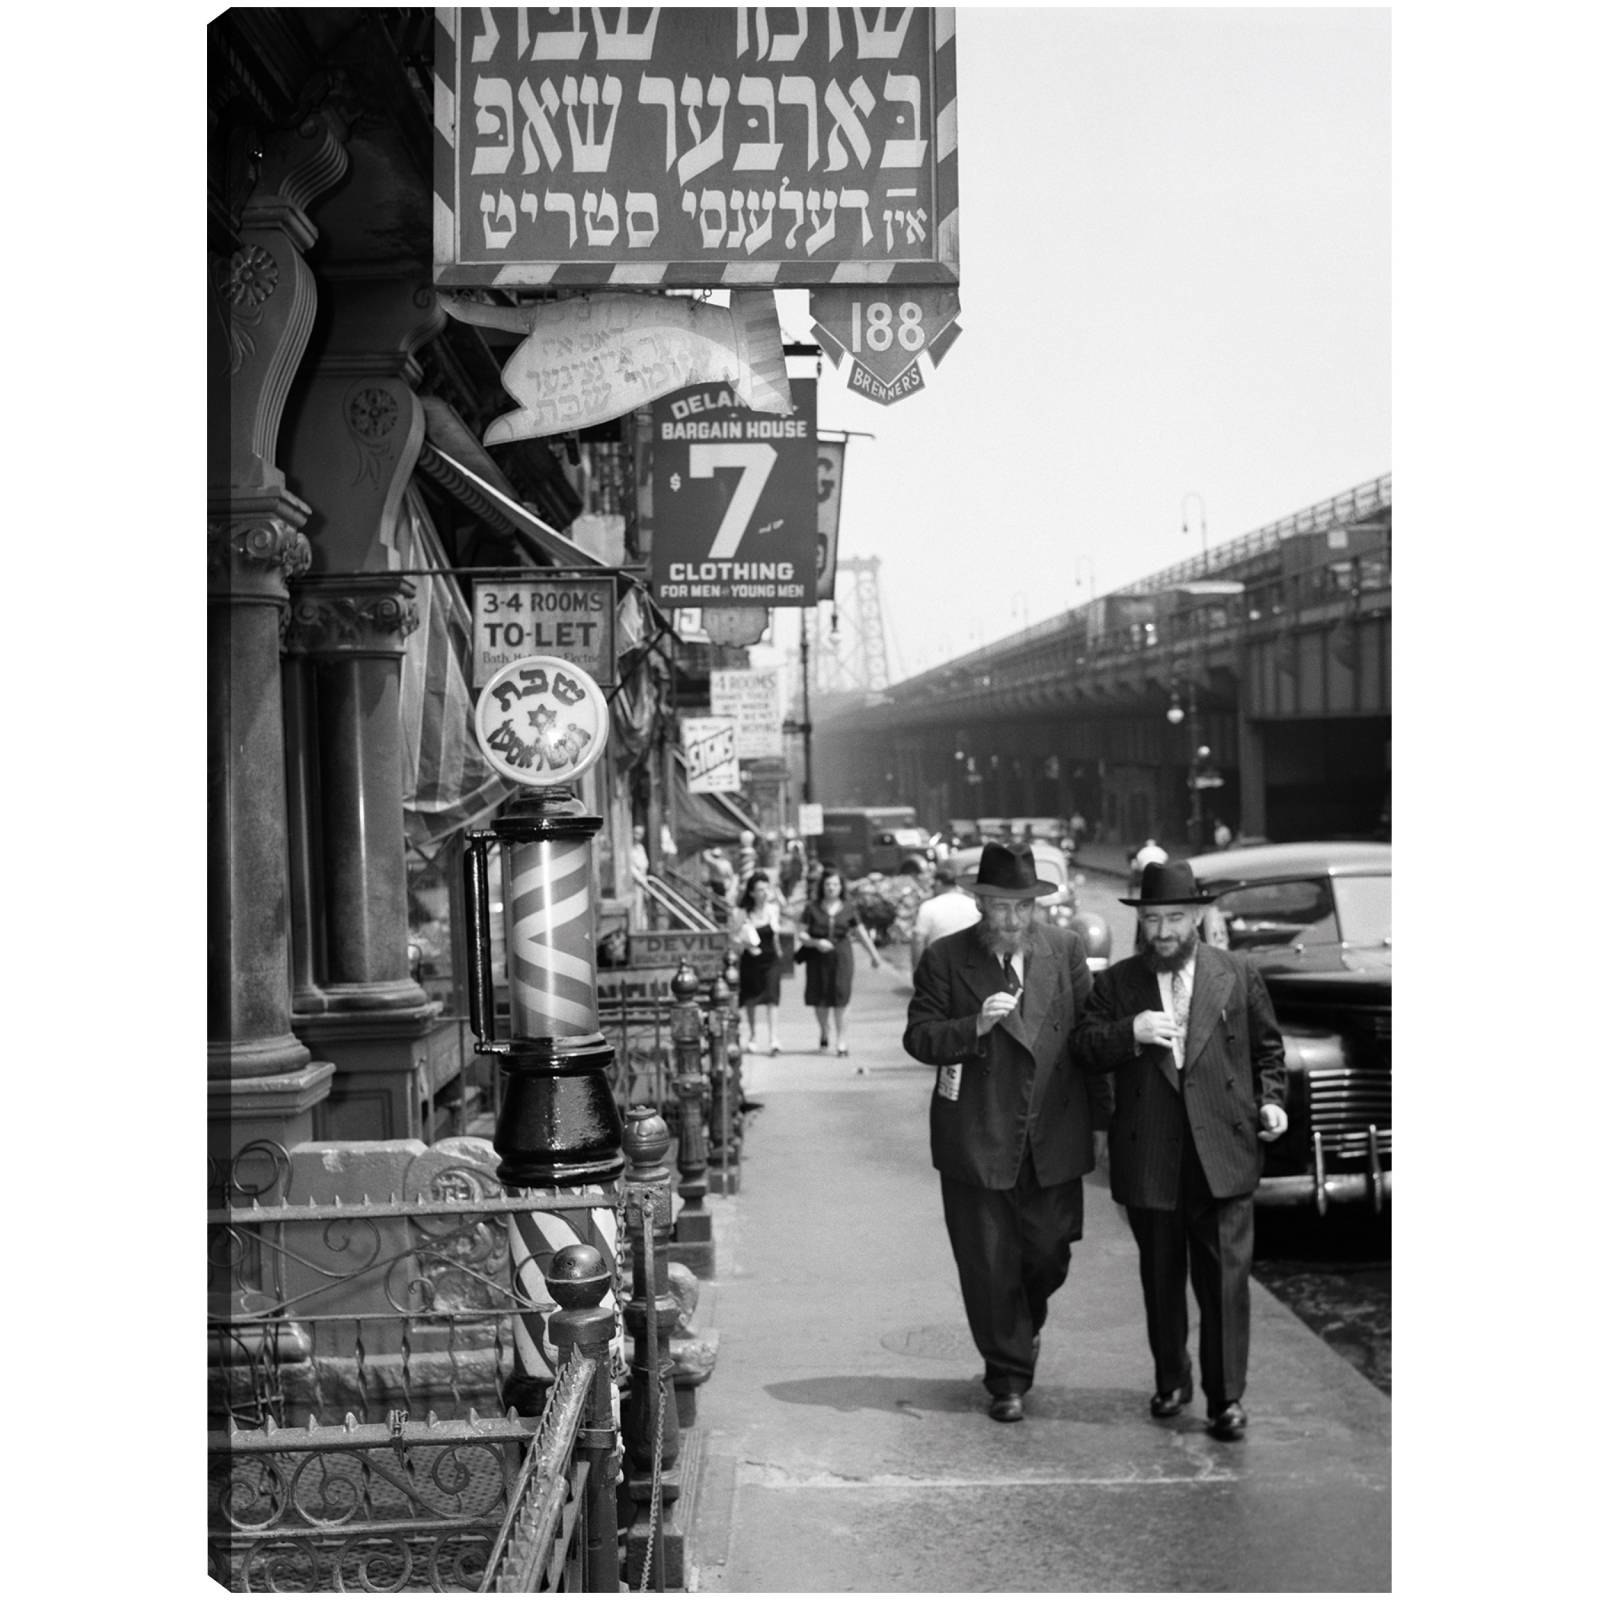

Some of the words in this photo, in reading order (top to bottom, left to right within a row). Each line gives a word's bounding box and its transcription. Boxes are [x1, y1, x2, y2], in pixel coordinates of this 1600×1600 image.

[480, 187, 660, 249] סטריט
[852, 302, 925, 353] 188
[853, 367, 920, 401] BRENNER'S
[661, 421, 742, 440] BARGAIN
[746, 420, 808, 438] HOUSE
[669, 473, 681, 491] $
[689, 443, 778, 559] 7
[669, 562, 794, 581] CLOTHING
[483, 592, 523, 614] 3-4
[531, 591, 604, 613] ROOMS
[660, 585, 688, 598] FOR
[691, 585, 720, 597] MEN
[731, 584, 776, 598] YOUNG
[777, 584, 804, 597] MEN
[483, 622, 598, 648] TO-LET
